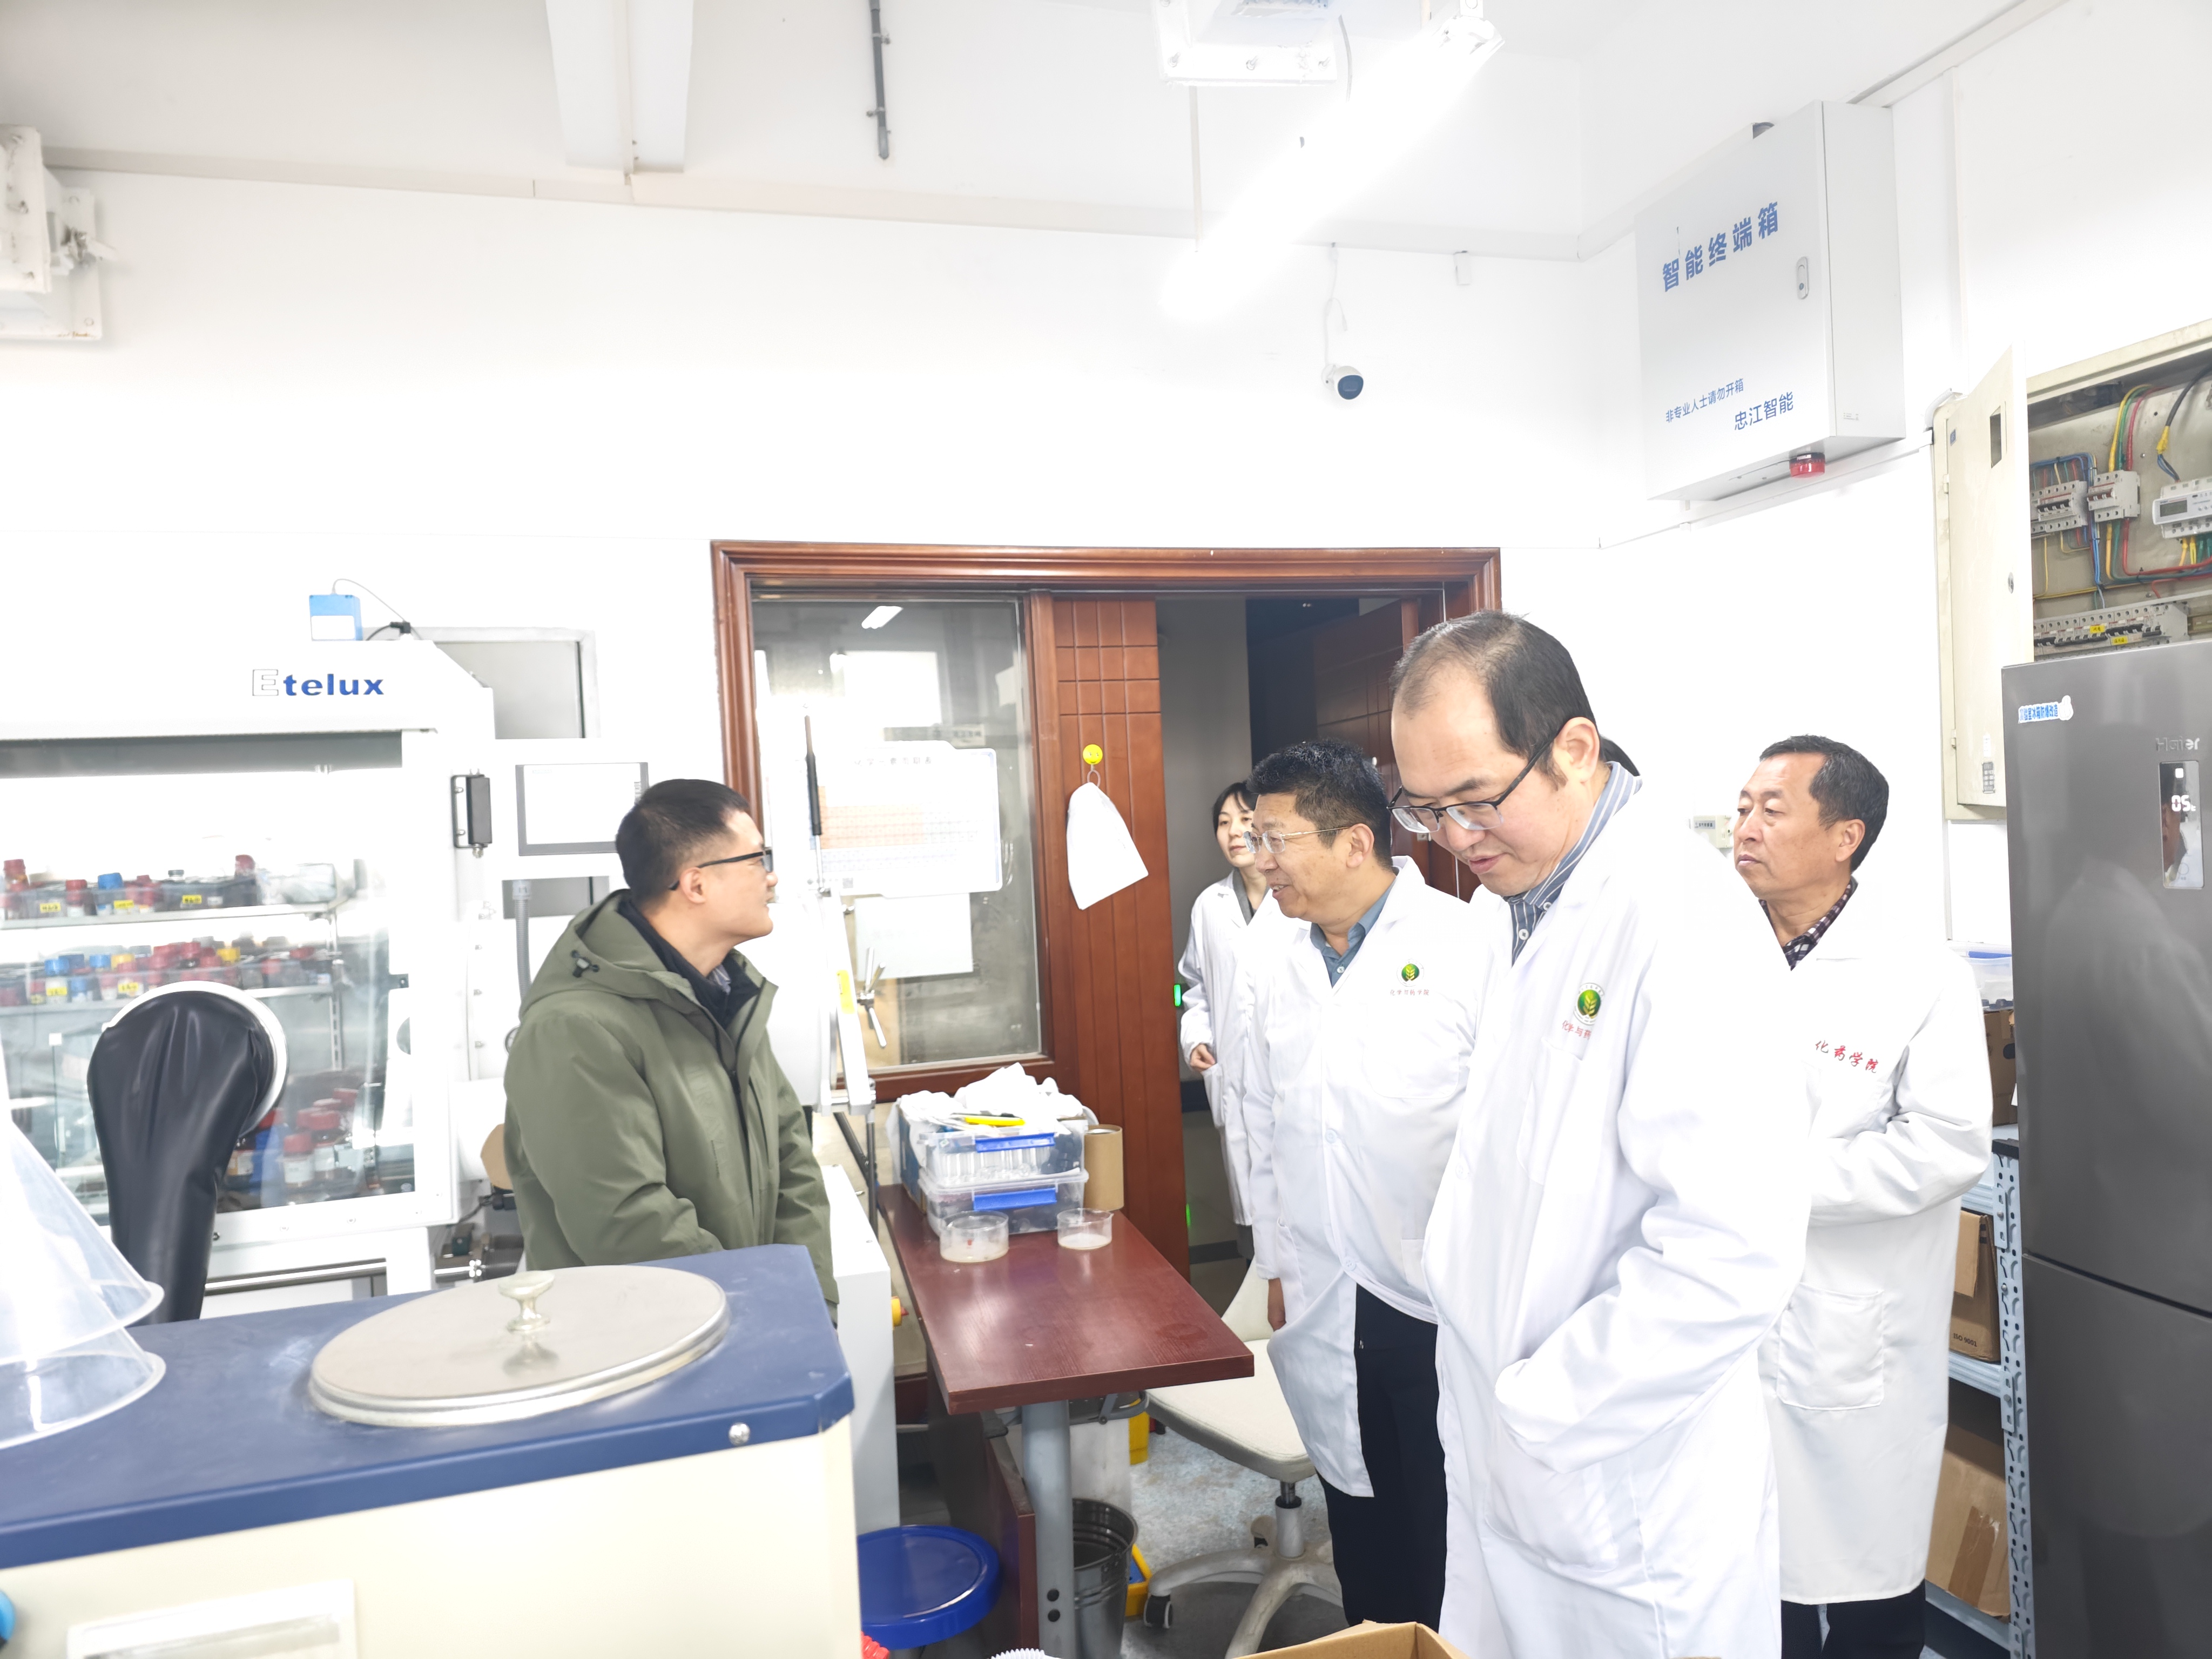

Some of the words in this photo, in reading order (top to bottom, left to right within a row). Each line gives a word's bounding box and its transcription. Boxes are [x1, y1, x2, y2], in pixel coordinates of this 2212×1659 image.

[1662, 201, 1779, 292] 智能终端箱
[1665, 378, 1744, 423] 非专业人士请勿开箱
[1734, 392, 1794, 431] 忠江智能
[252, 669, 385, 697] Etelux
[2155, 736, 2200, 752] Haier
[1815, 1040, 1880, 1074] 化药学院
[1953, 1333, 1963, 1341] ISO
[1964, 1337, 1978, 1347] 9001
